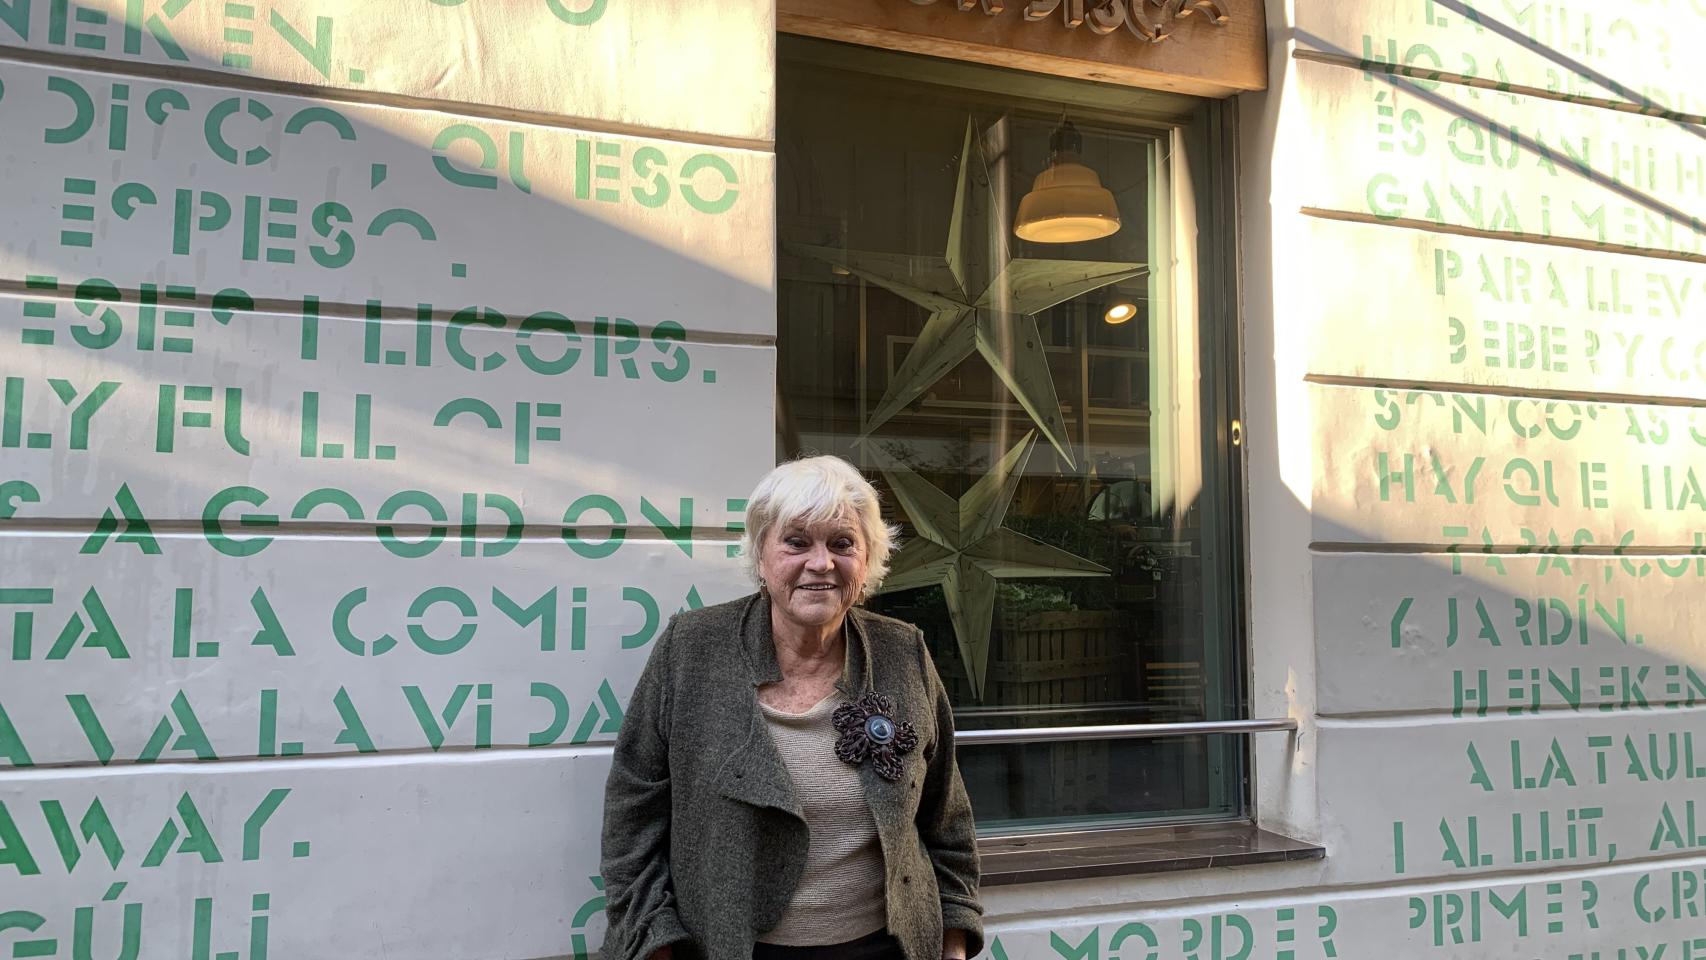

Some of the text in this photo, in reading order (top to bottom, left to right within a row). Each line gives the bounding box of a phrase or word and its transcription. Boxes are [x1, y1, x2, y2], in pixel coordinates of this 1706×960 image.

[79, 482, 163, 554] A
[200, 485, 525, 559] GOOD
[1510, 735, 1577, 790] LA
